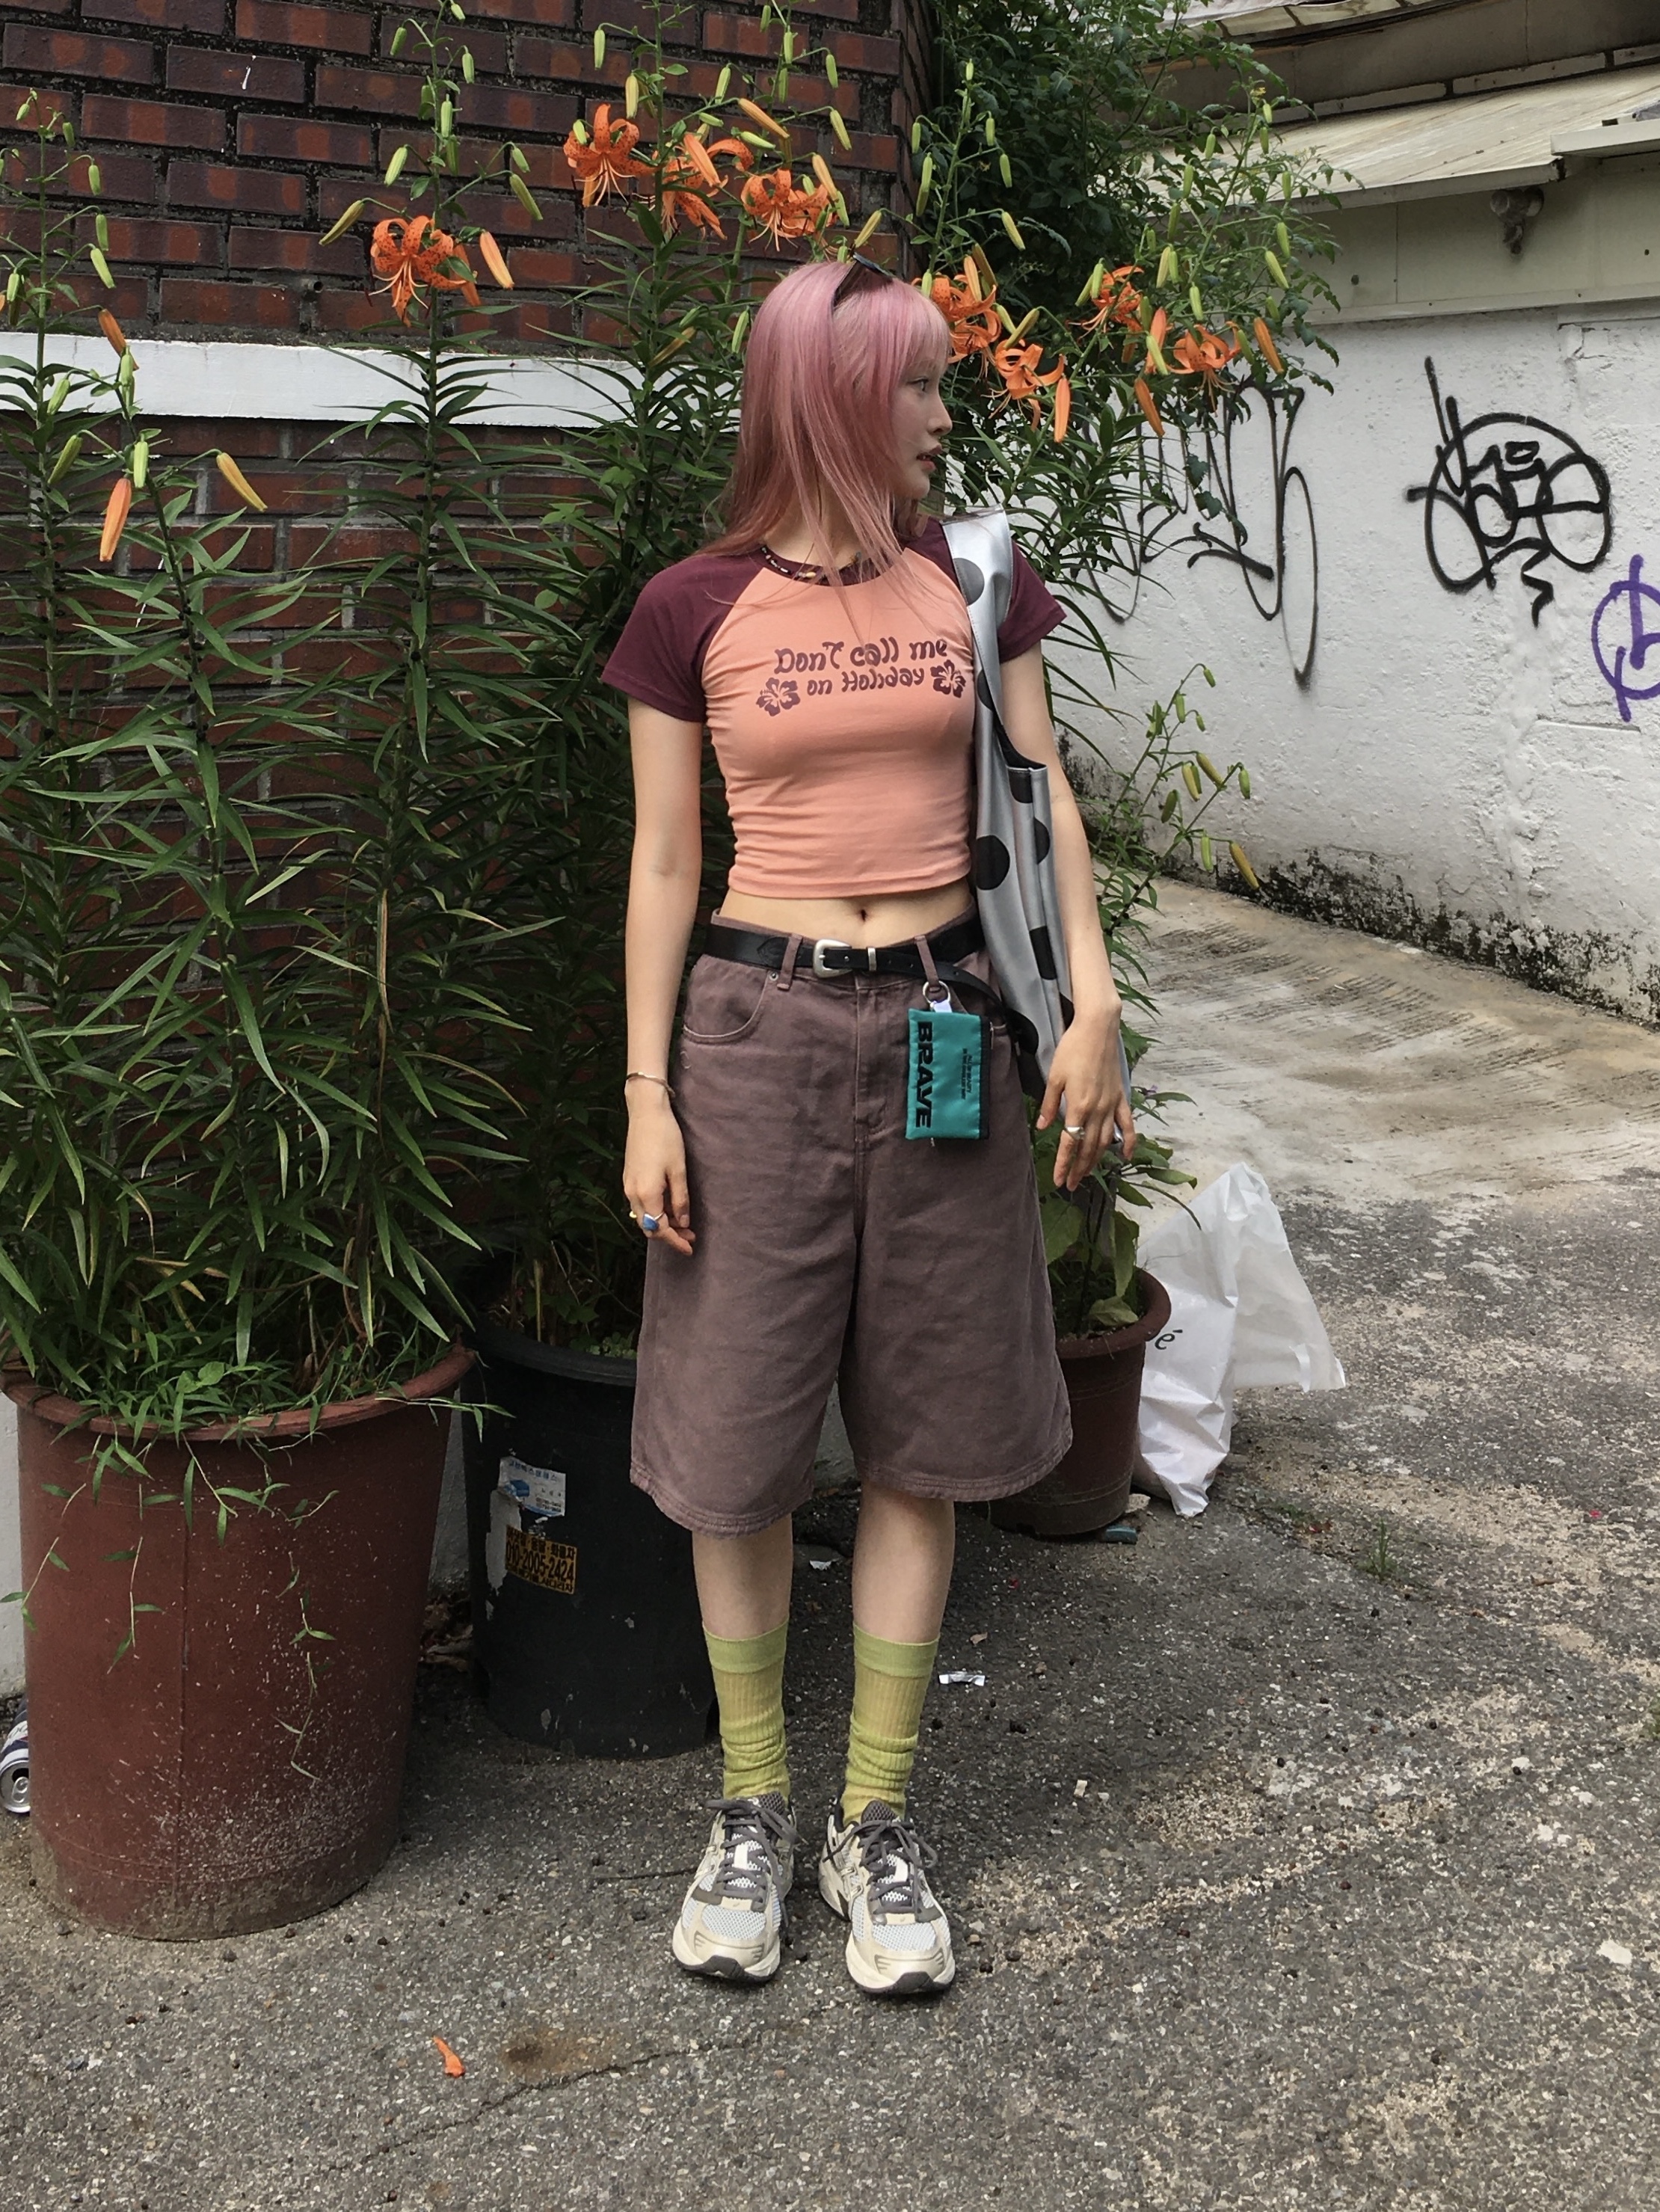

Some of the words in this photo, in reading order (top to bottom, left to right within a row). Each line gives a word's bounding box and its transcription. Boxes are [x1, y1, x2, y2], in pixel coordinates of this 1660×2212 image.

[850, 636, 899, 667] call
[909, 639, 947, 661] me
[807, 679, 833, 696] on
[841, 666, 925, 692] Holiday
[915, 1021, 934, 1128] BRAVE
[506, 1540, 574, 1583] 010-2005-2424
